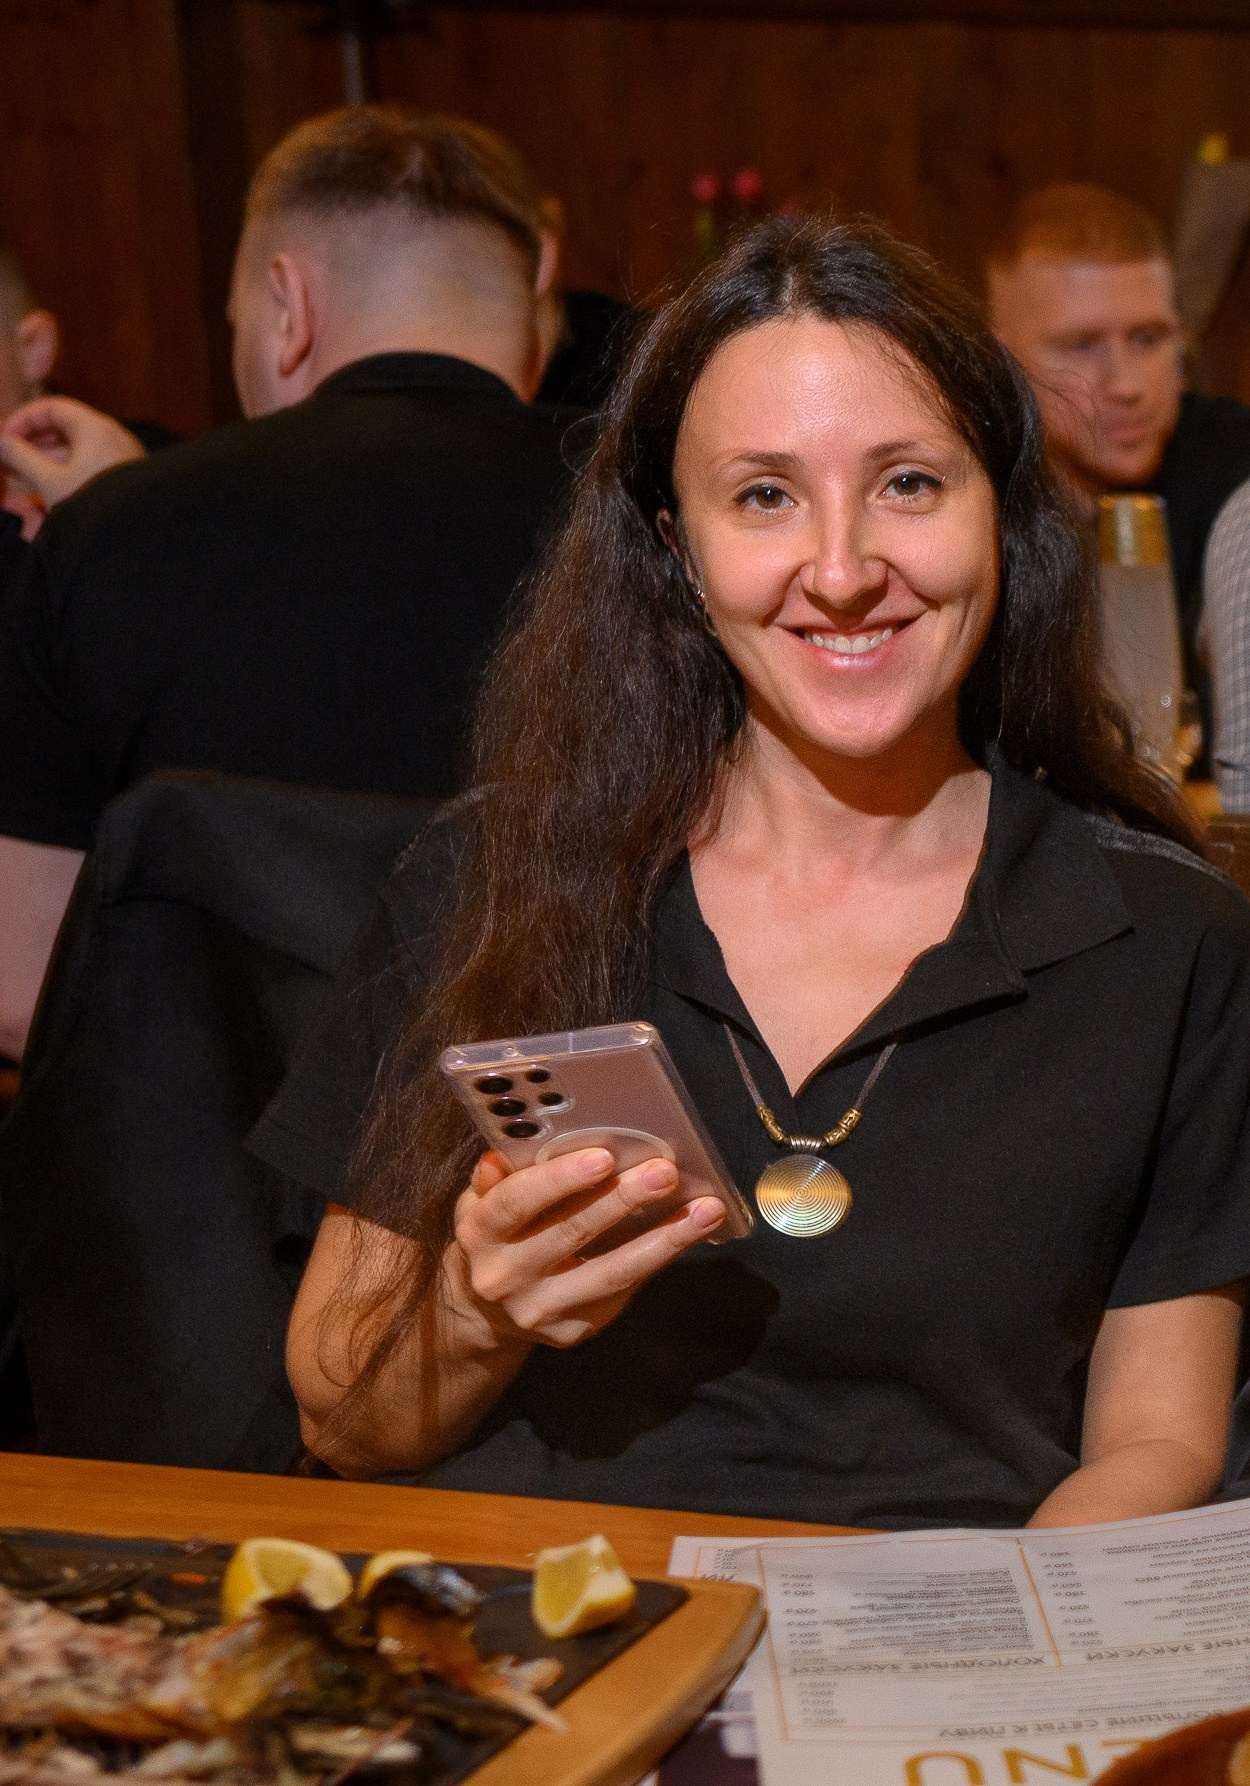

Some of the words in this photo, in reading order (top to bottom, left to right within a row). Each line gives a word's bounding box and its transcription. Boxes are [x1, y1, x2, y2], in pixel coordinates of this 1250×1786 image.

[1082, 1644, 1197, 1661] ЗАКУСКИ
[789, 1664, 903, 1674] ЗАКУСКИ
[909, 1658, 1046, 1670] ХОЛОДНЫЕ
[903, 1740, 1142, 1786] NU
